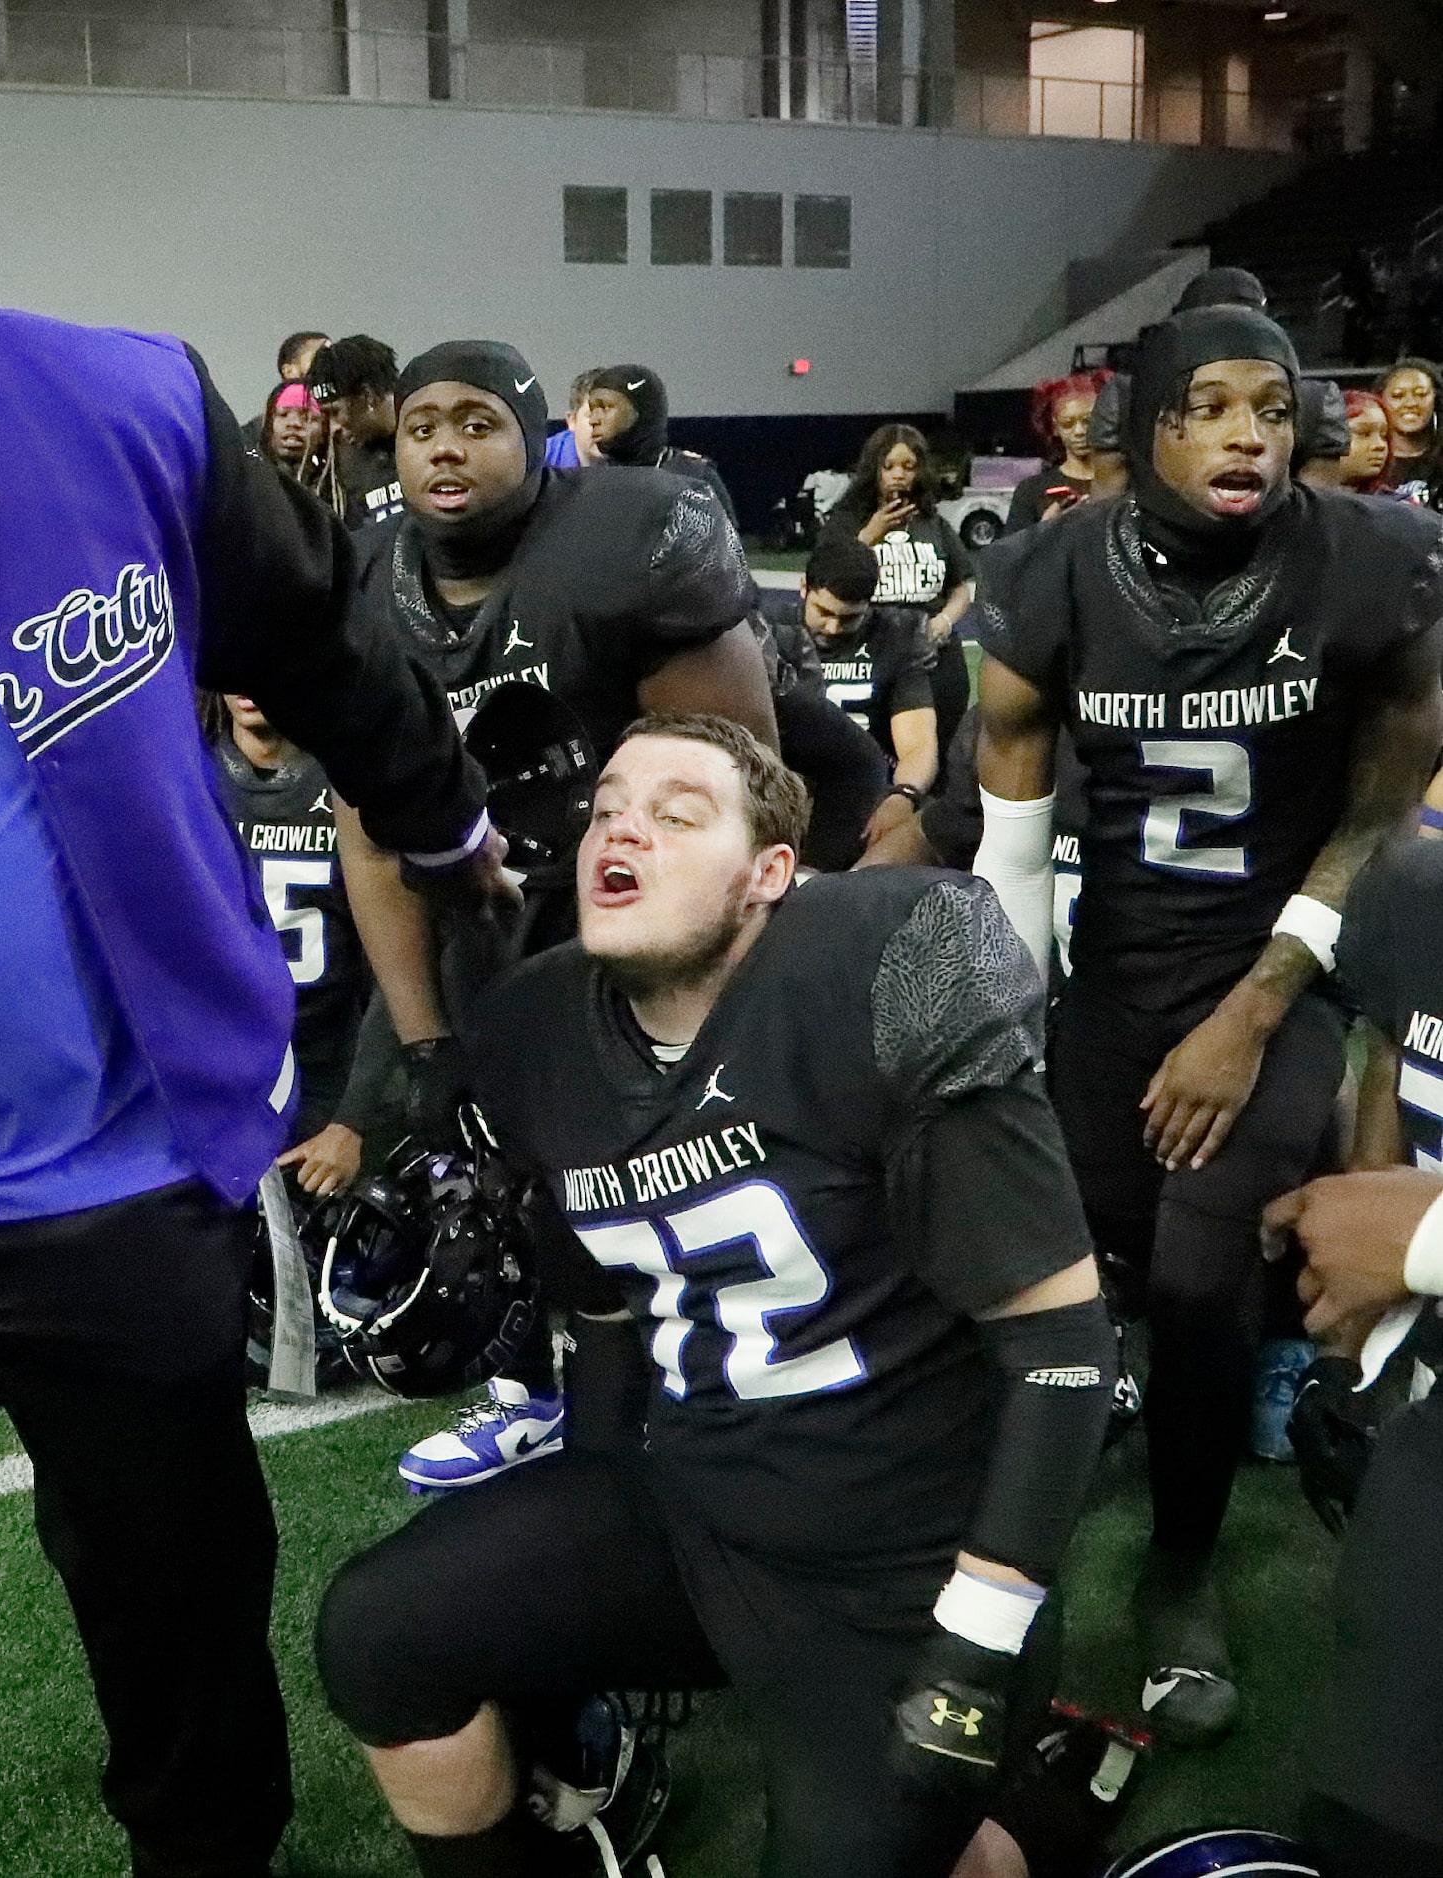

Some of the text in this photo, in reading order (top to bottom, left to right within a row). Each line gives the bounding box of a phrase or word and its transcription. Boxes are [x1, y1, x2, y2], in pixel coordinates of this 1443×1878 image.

[874, 559, 946, 596] SINESS
[12, 563, 175, 690] City
[1078, 677, 1319, 730] NORTH CROWLEY
[250, 824, 337, 852] CROWLEY
[1140, 740, 1252, 874] 2
[563, 1121, 768, 1212] NORTH CROWLEY
[573, 1184, 863, 1401] 72
